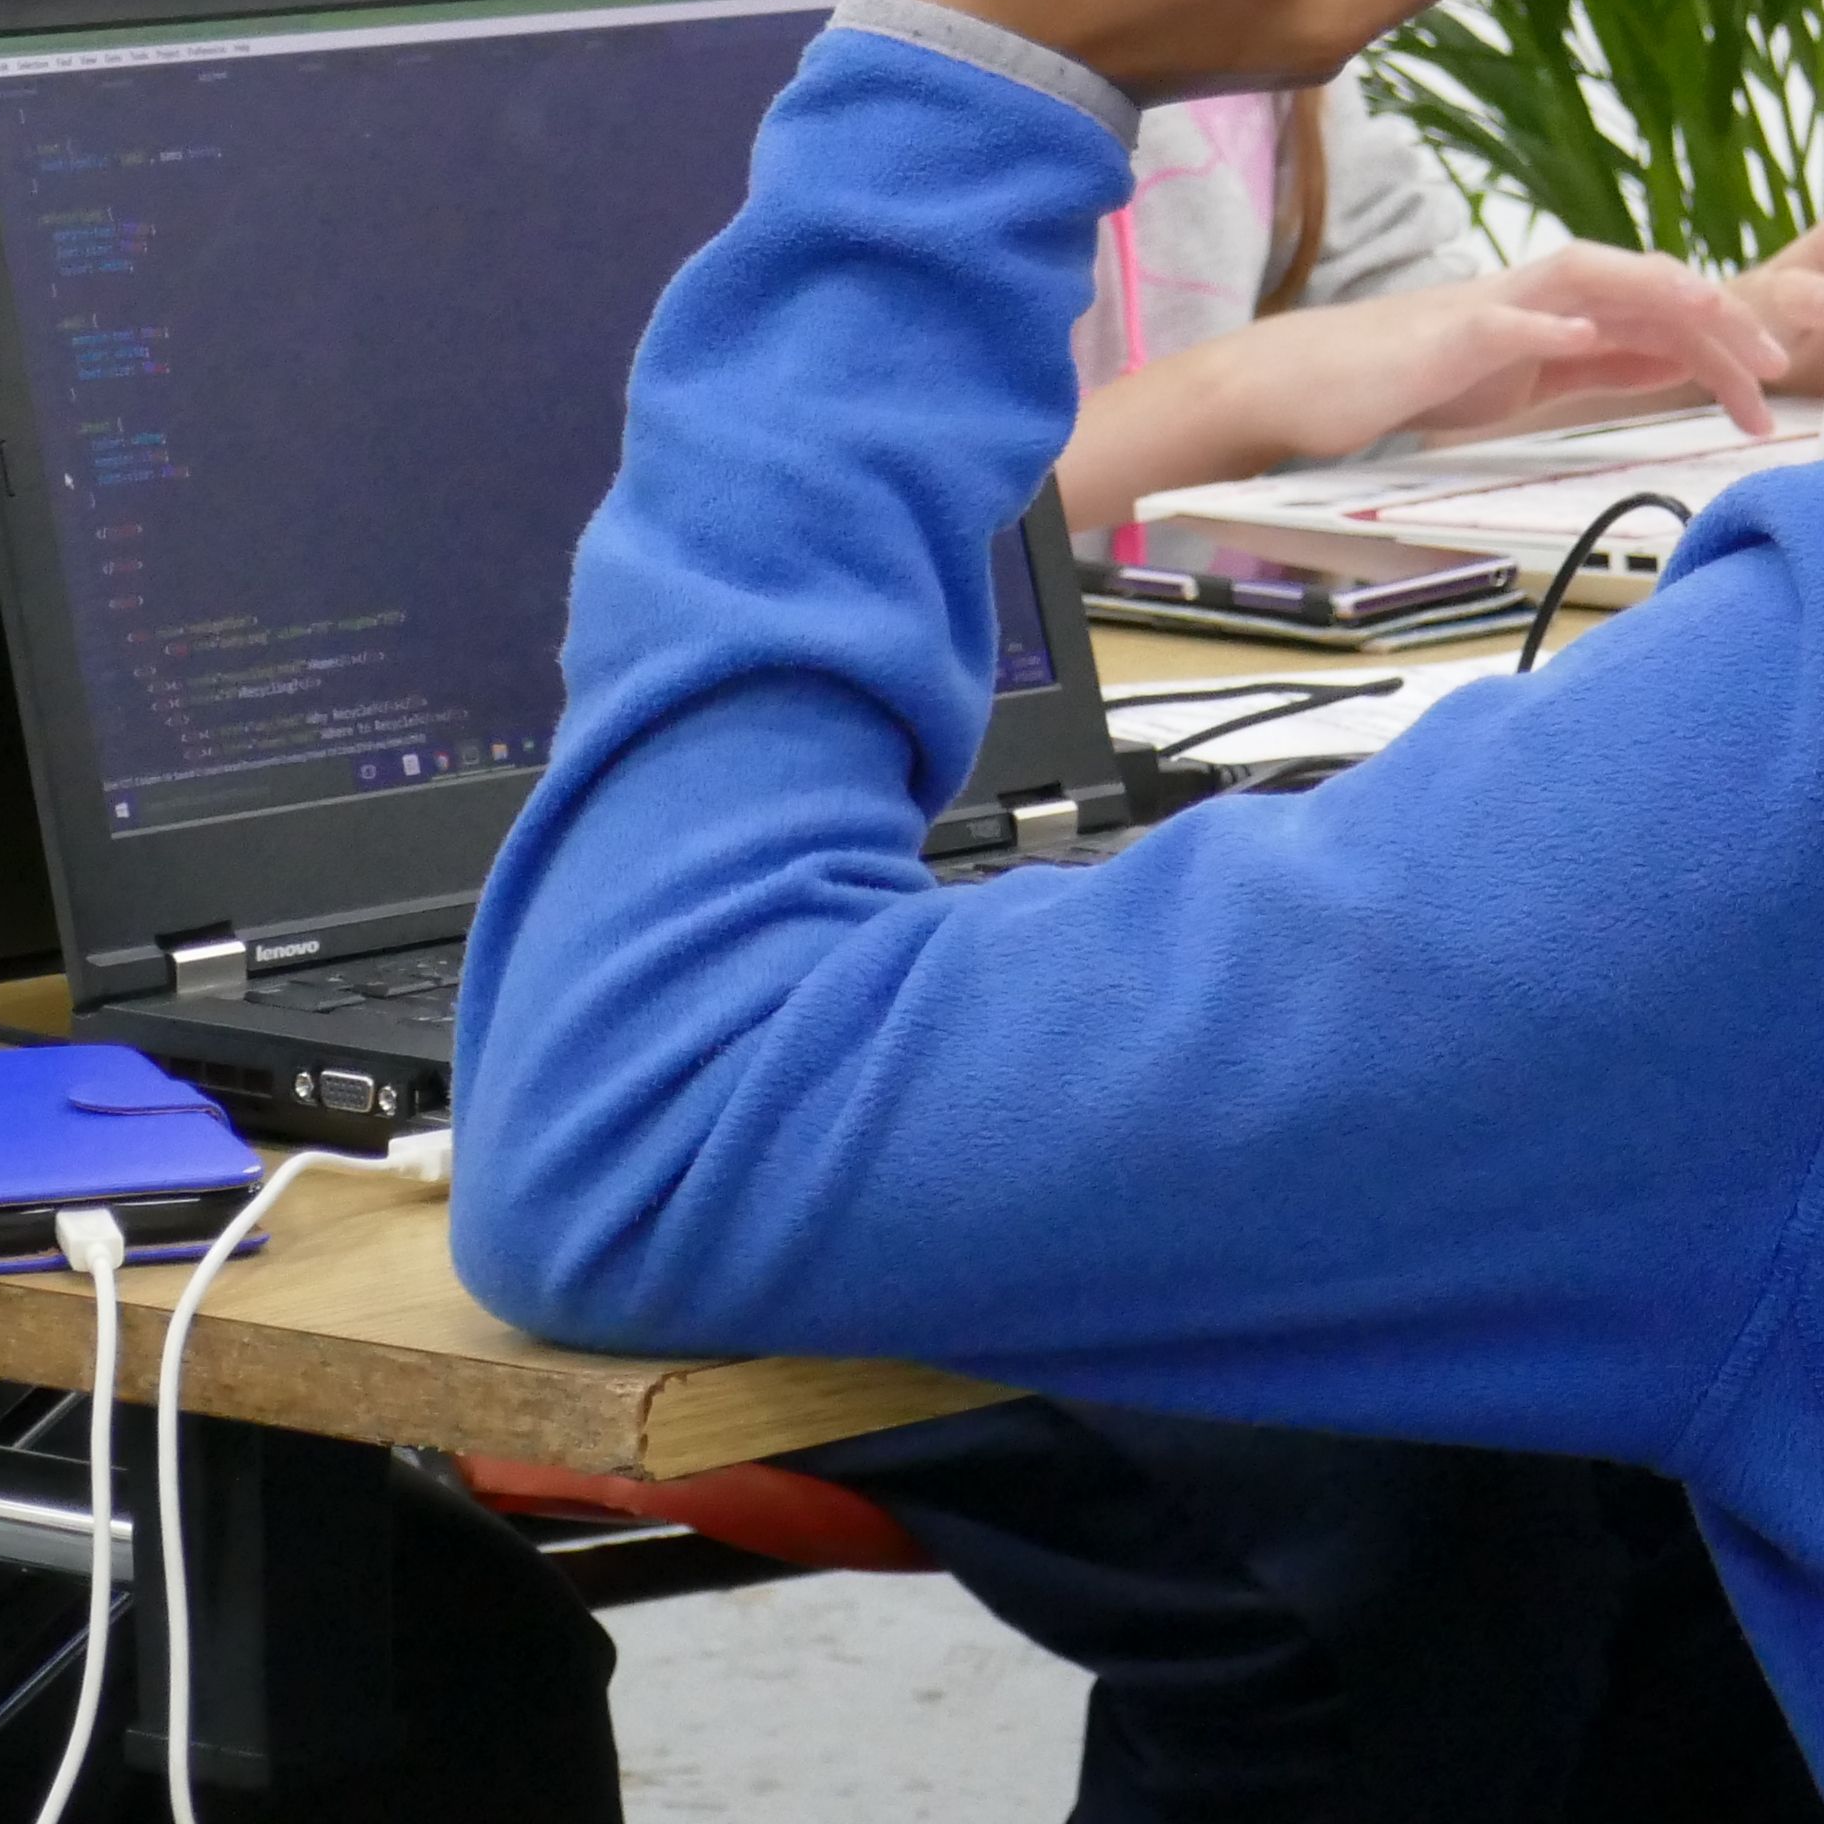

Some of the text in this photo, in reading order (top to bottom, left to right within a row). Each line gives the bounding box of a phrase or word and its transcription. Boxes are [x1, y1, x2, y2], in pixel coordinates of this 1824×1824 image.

[17, 57, 49, 71] Selection
[56, 56, 73, 68] Find
[80, 54, 97, 66] View
[256, 941, 320, 962] lenovo
